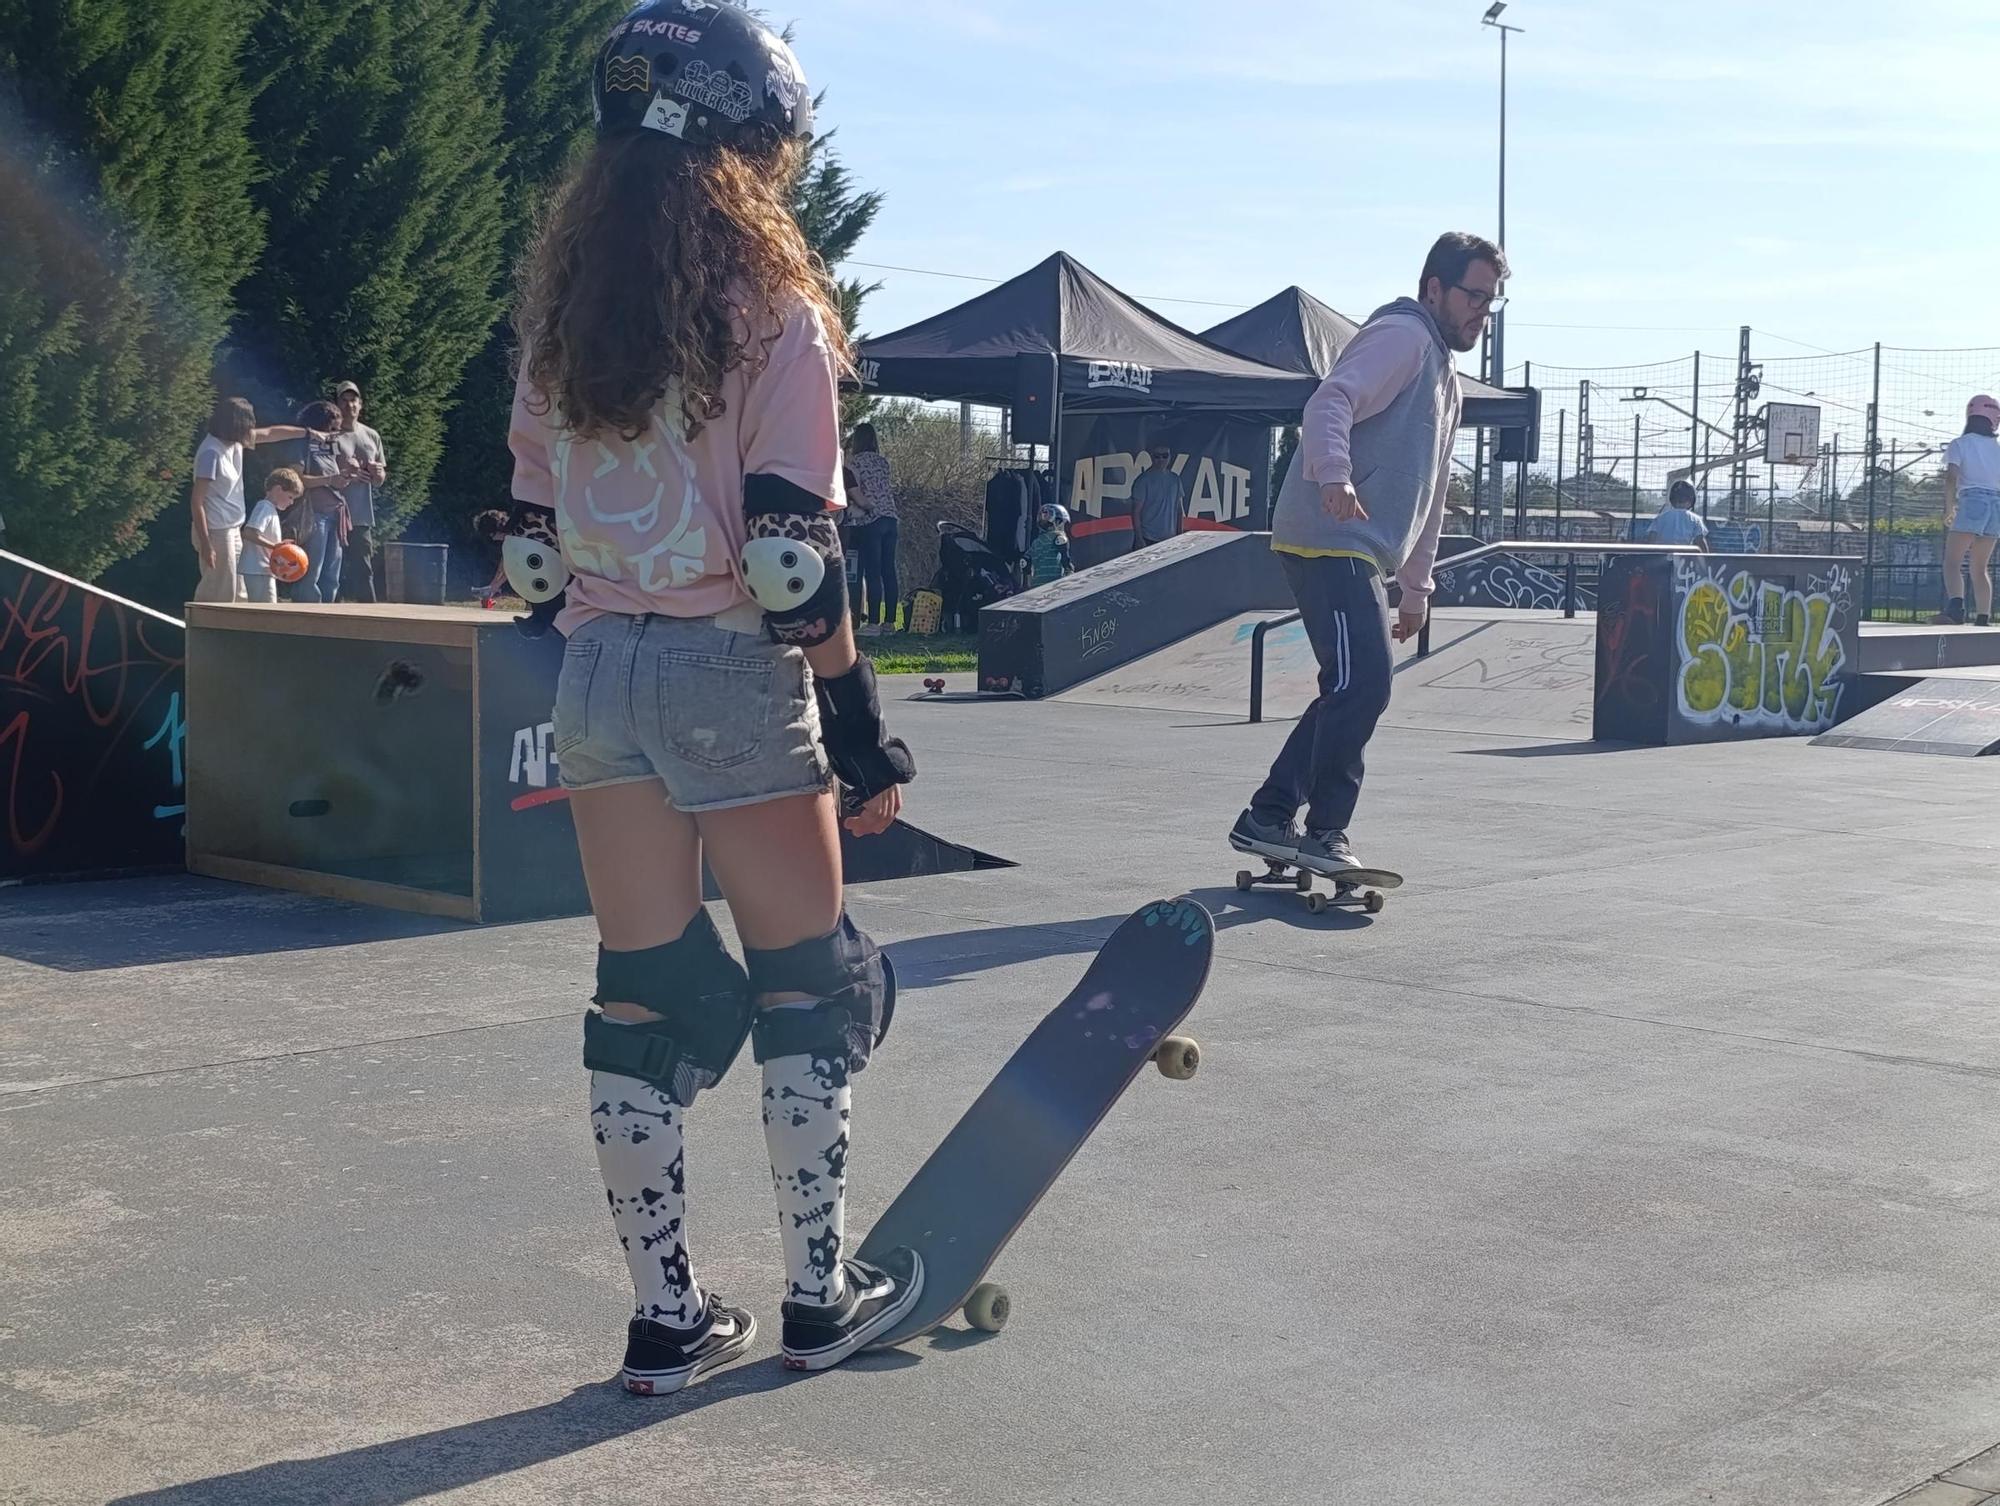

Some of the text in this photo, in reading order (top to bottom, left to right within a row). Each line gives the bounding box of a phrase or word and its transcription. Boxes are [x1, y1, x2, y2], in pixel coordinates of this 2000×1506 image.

[632, 19, 701, 44] SKATES
[674, 79, 752, 121] KILLER PADS
[685, 60, 752, 107] 187
[1088, 361, 1152, 388] APSKATE
